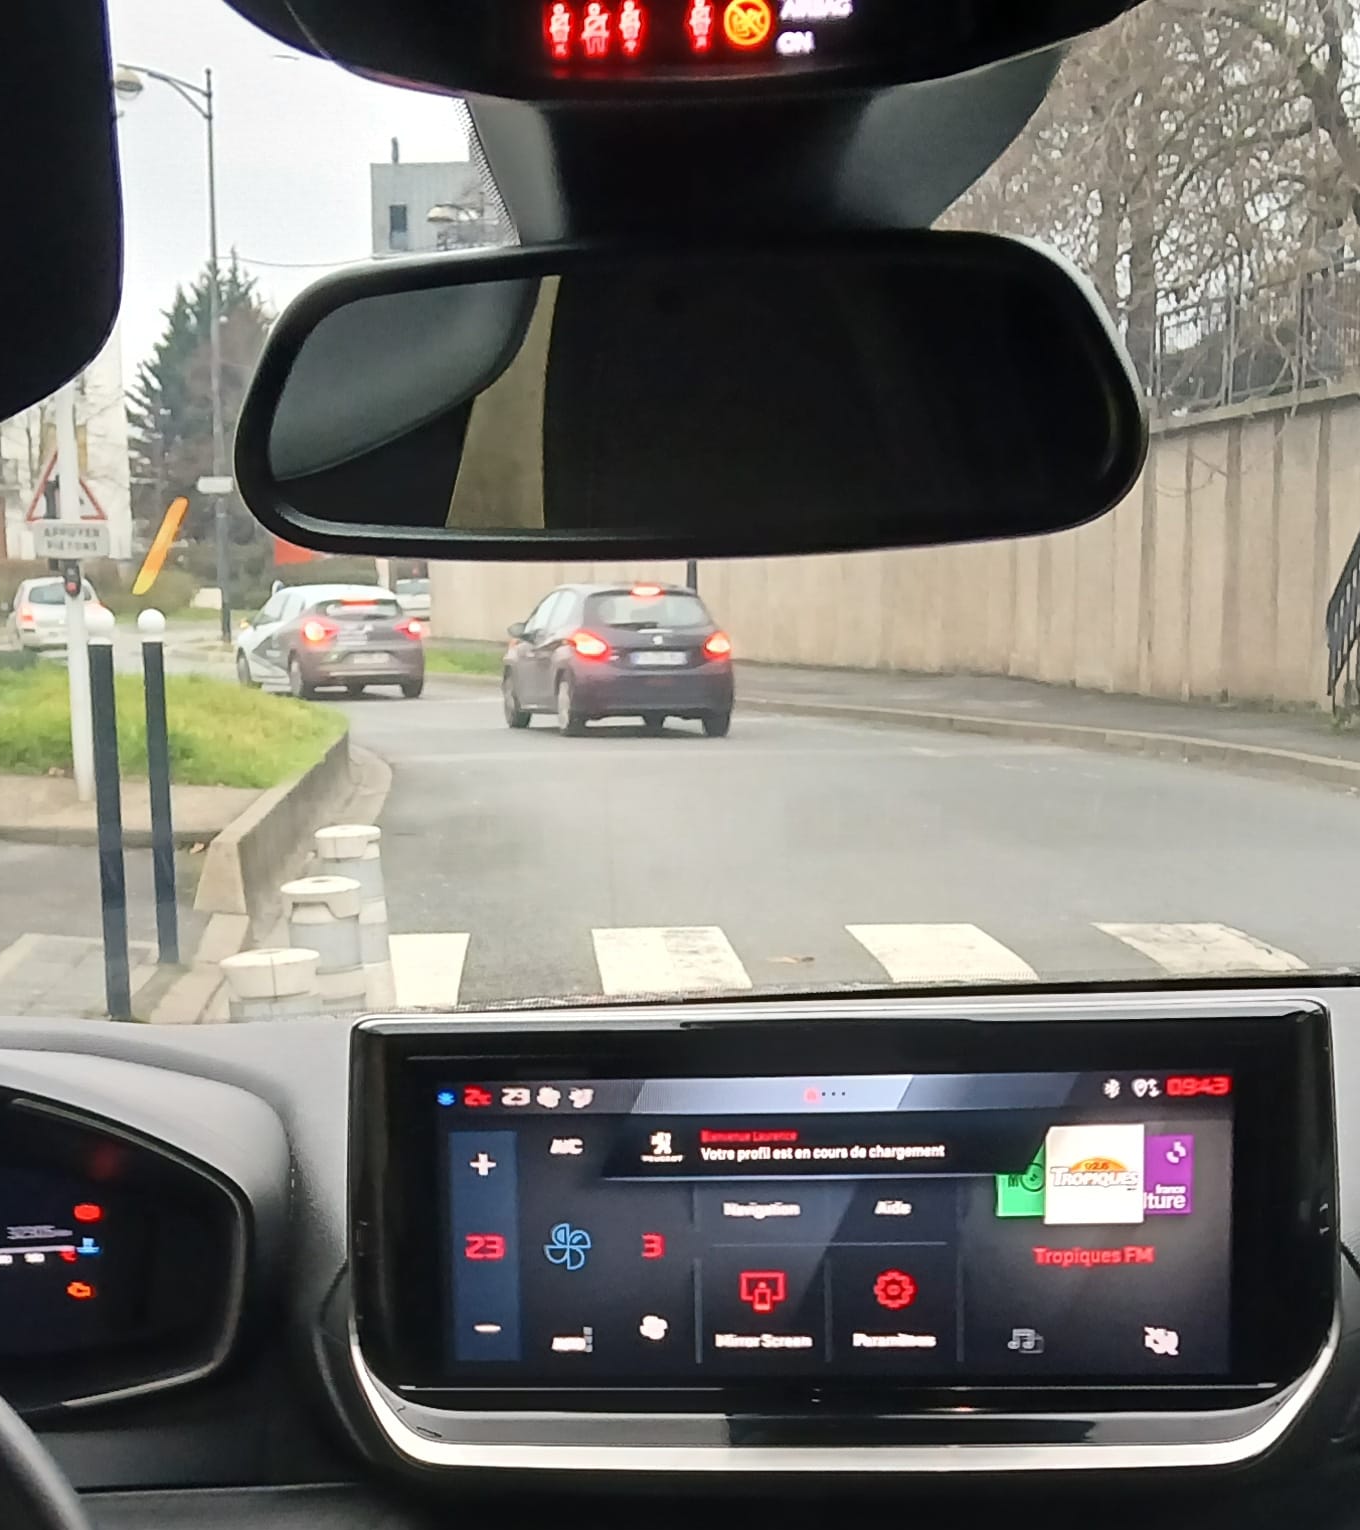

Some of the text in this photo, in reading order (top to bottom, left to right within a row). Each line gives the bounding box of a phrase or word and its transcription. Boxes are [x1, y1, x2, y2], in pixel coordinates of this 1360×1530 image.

[776, 29, 815, 55] ON
[701, 1144, 945, 1162] Votre profil est en cours de chargement
[1143, 1192, 1187, 1210] lture
[465, 1233, 506, 1261] 23
[642, 1233, 665, 1259] 3
[1033, 1246, 1155, 1267] Tropiques FM
